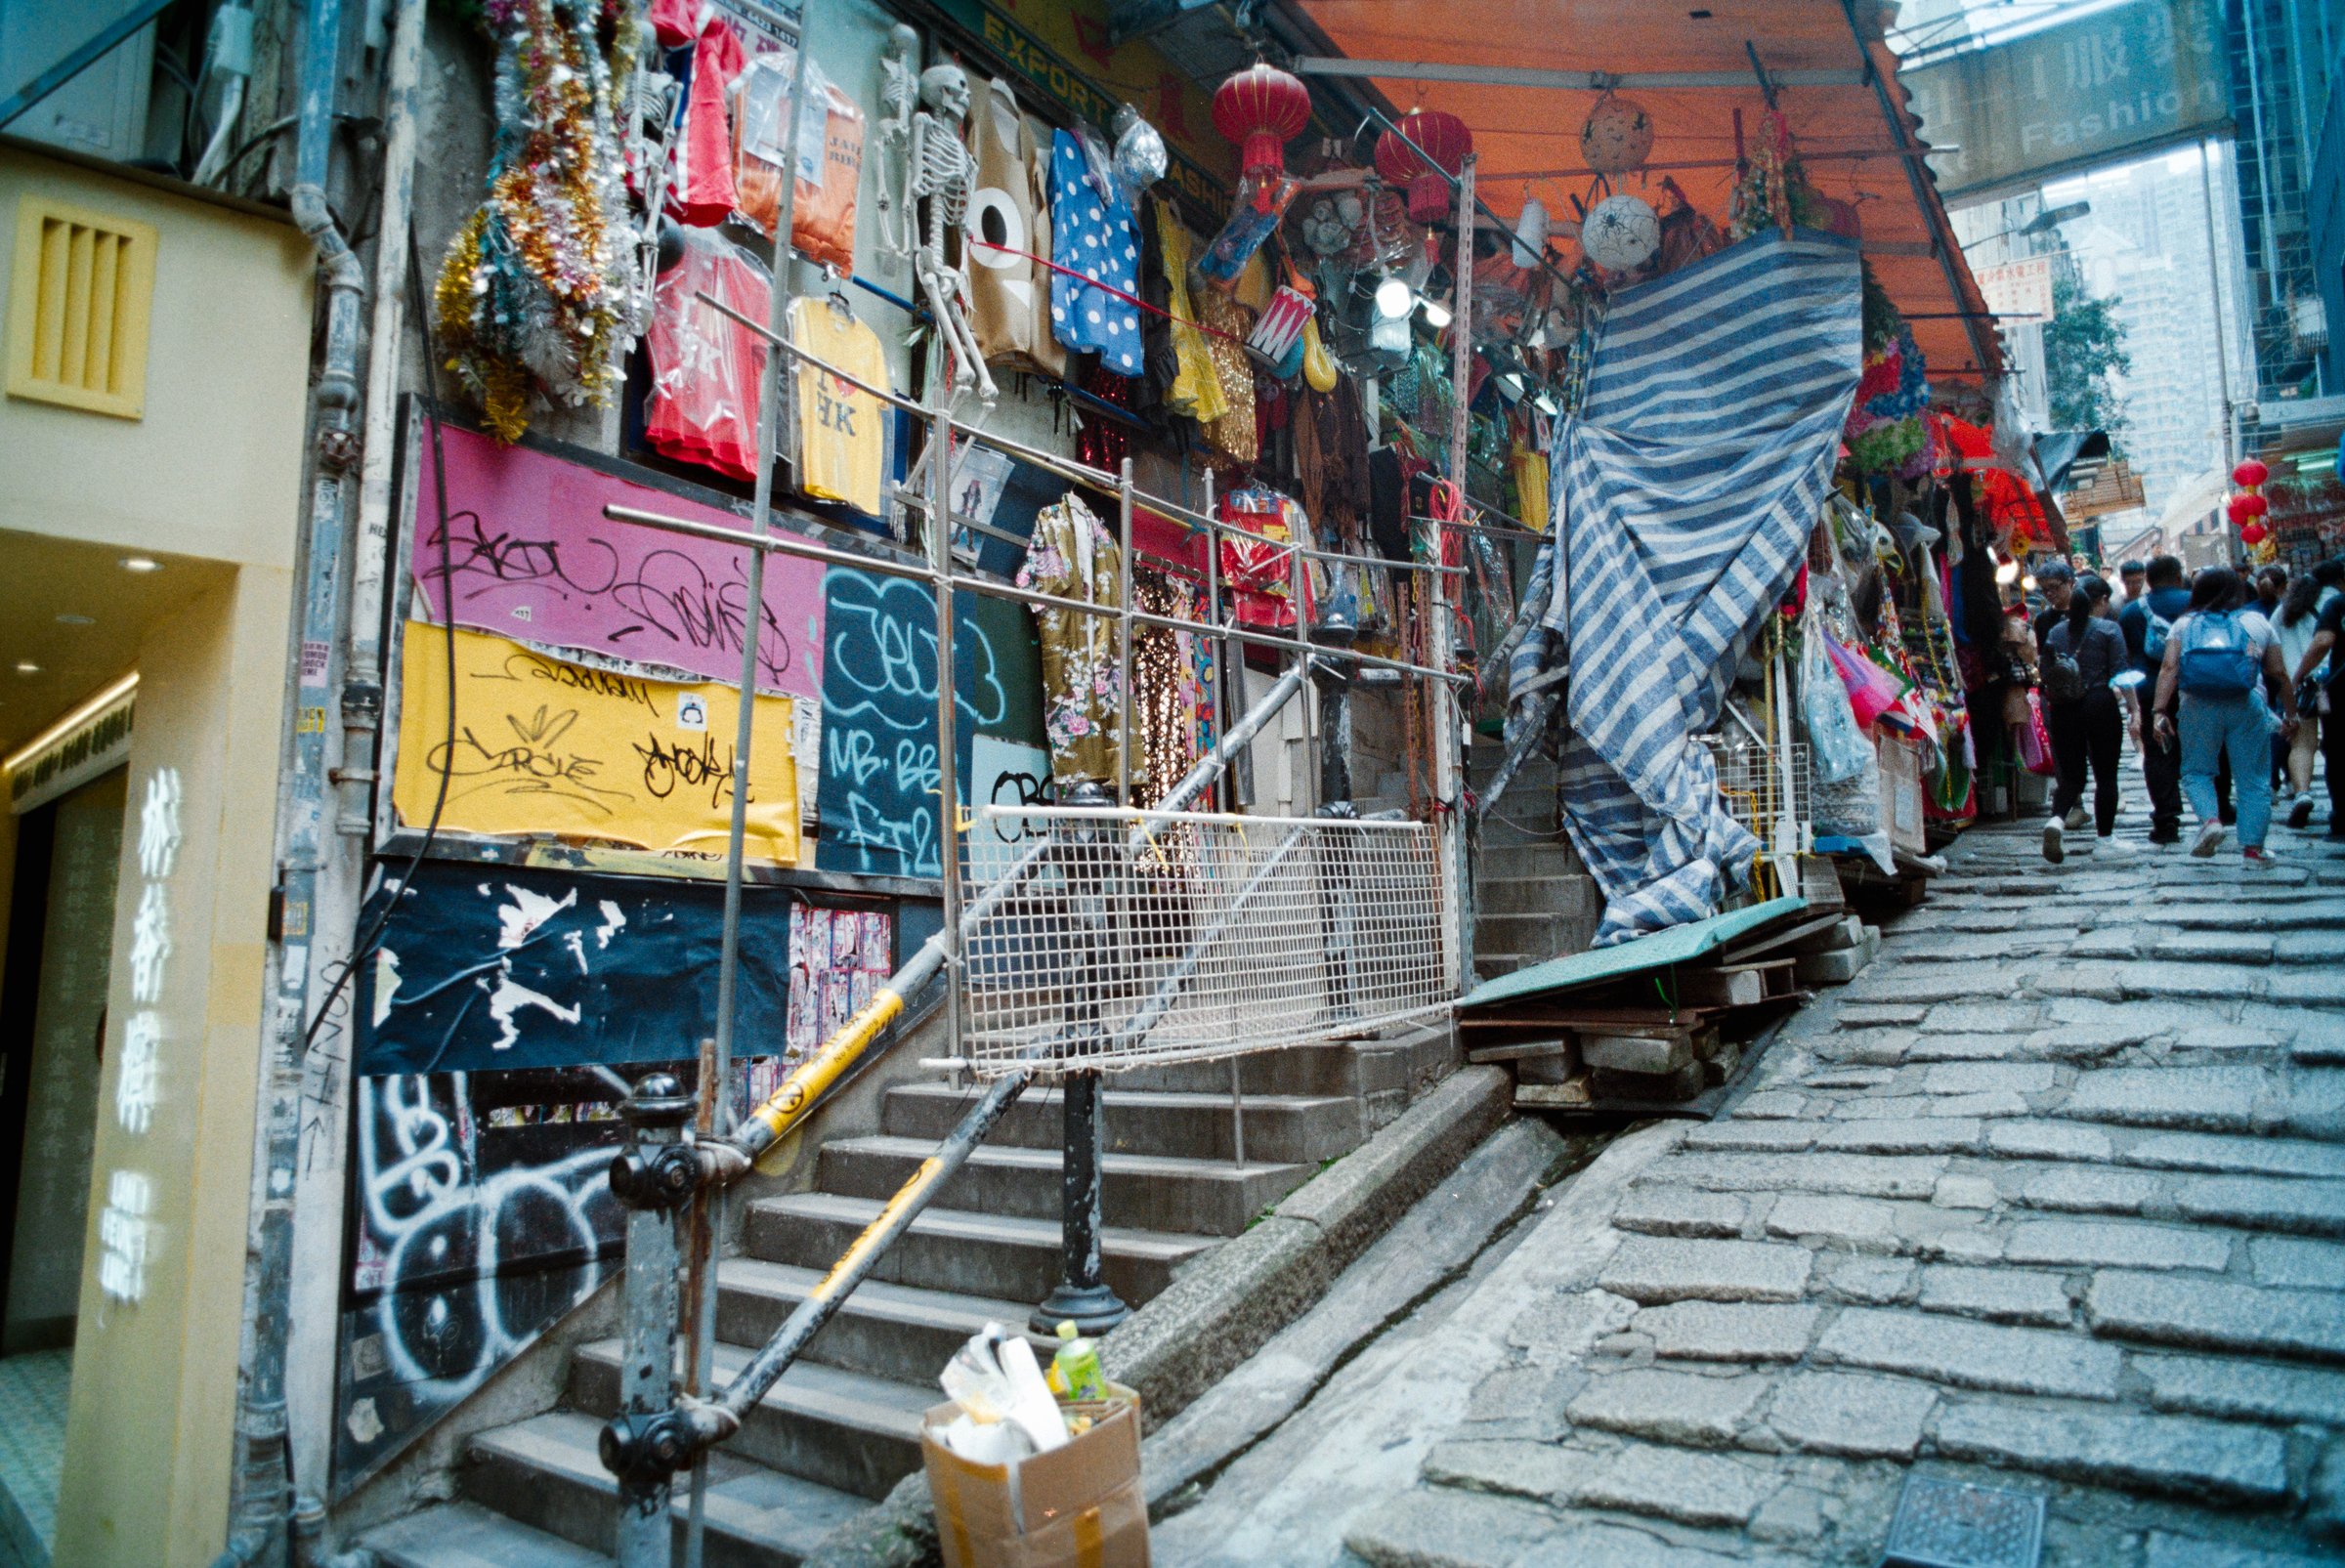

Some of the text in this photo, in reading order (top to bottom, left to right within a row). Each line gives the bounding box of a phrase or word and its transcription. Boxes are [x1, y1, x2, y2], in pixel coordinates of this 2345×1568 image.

[982, 12, 1108, 125] EXPORT
[2020, 77, 2219, 155] Fashion
[817, 391, 867, 438] HK
[845, 1017, 880, 1051] Smoking
